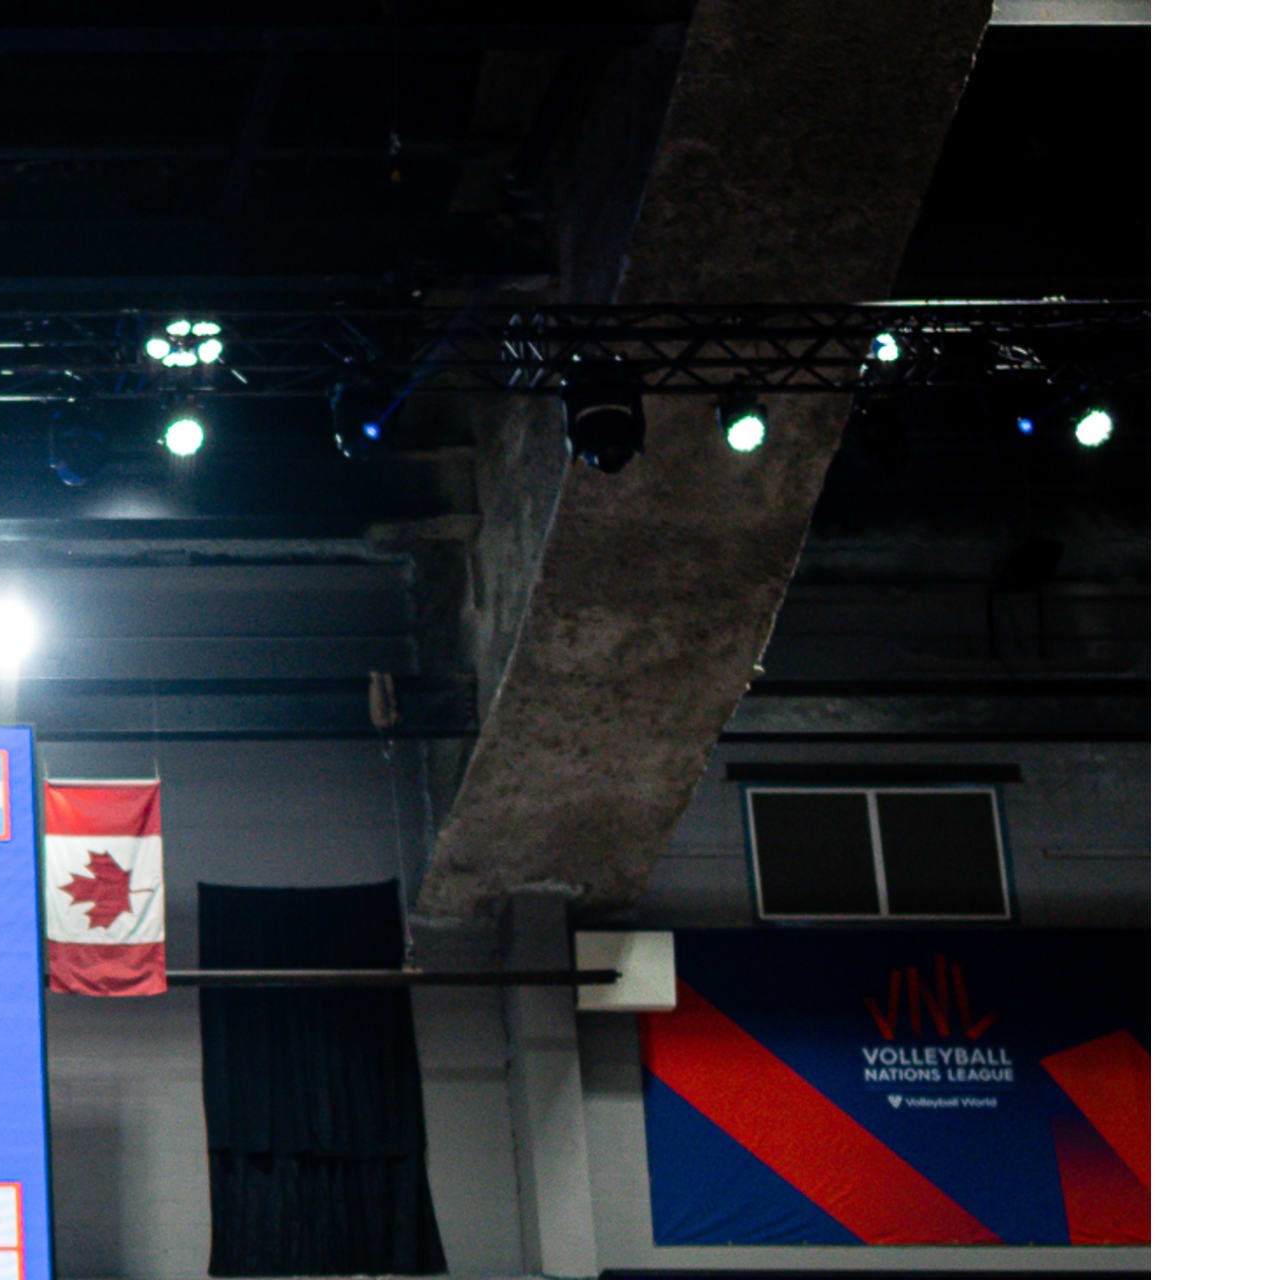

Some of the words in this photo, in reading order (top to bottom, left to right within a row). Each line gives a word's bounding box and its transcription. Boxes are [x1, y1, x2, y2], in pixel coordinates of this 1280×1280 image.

[864, 953, 1000, 1041] VNL
[862, 1047, 1012, 1066] VOLLEYBALL
[864, 1068, 941, 1082] NATIONS
[947, 1068, 1014, 1082] LEAGUE
